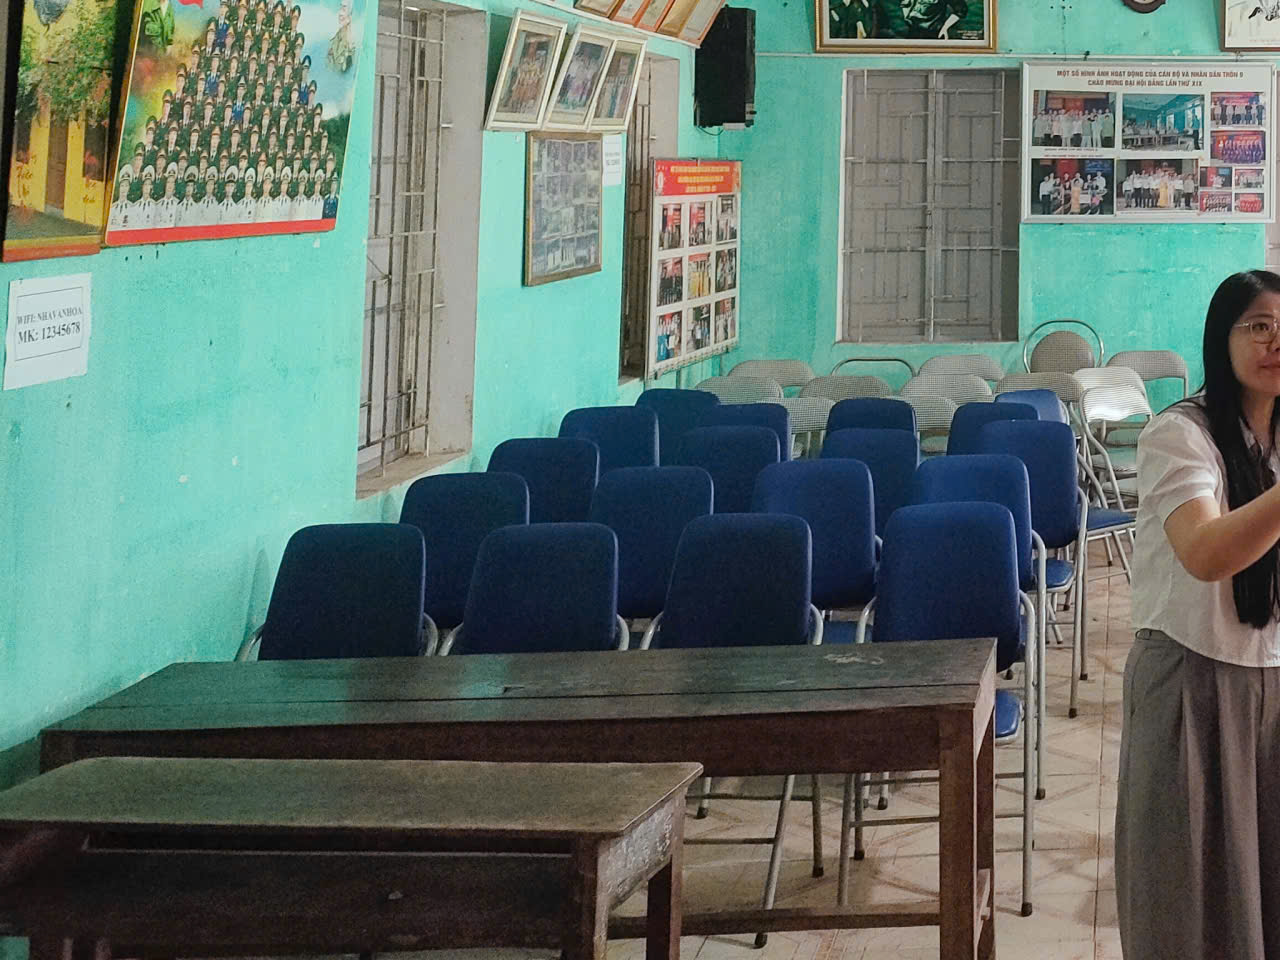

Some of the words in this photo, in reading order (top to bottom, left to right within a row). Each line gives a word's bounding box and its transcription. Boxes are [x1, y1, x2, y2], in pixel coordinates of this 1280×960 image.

[1145, 68, 1157, 77] CỦA
[17, 314, 36, 325] WIFI:
[37, 306, 83, 321] NHAVANHOA
[18, 329, 39, 344] MK:
[42, 321, 81, 340] 12345678
